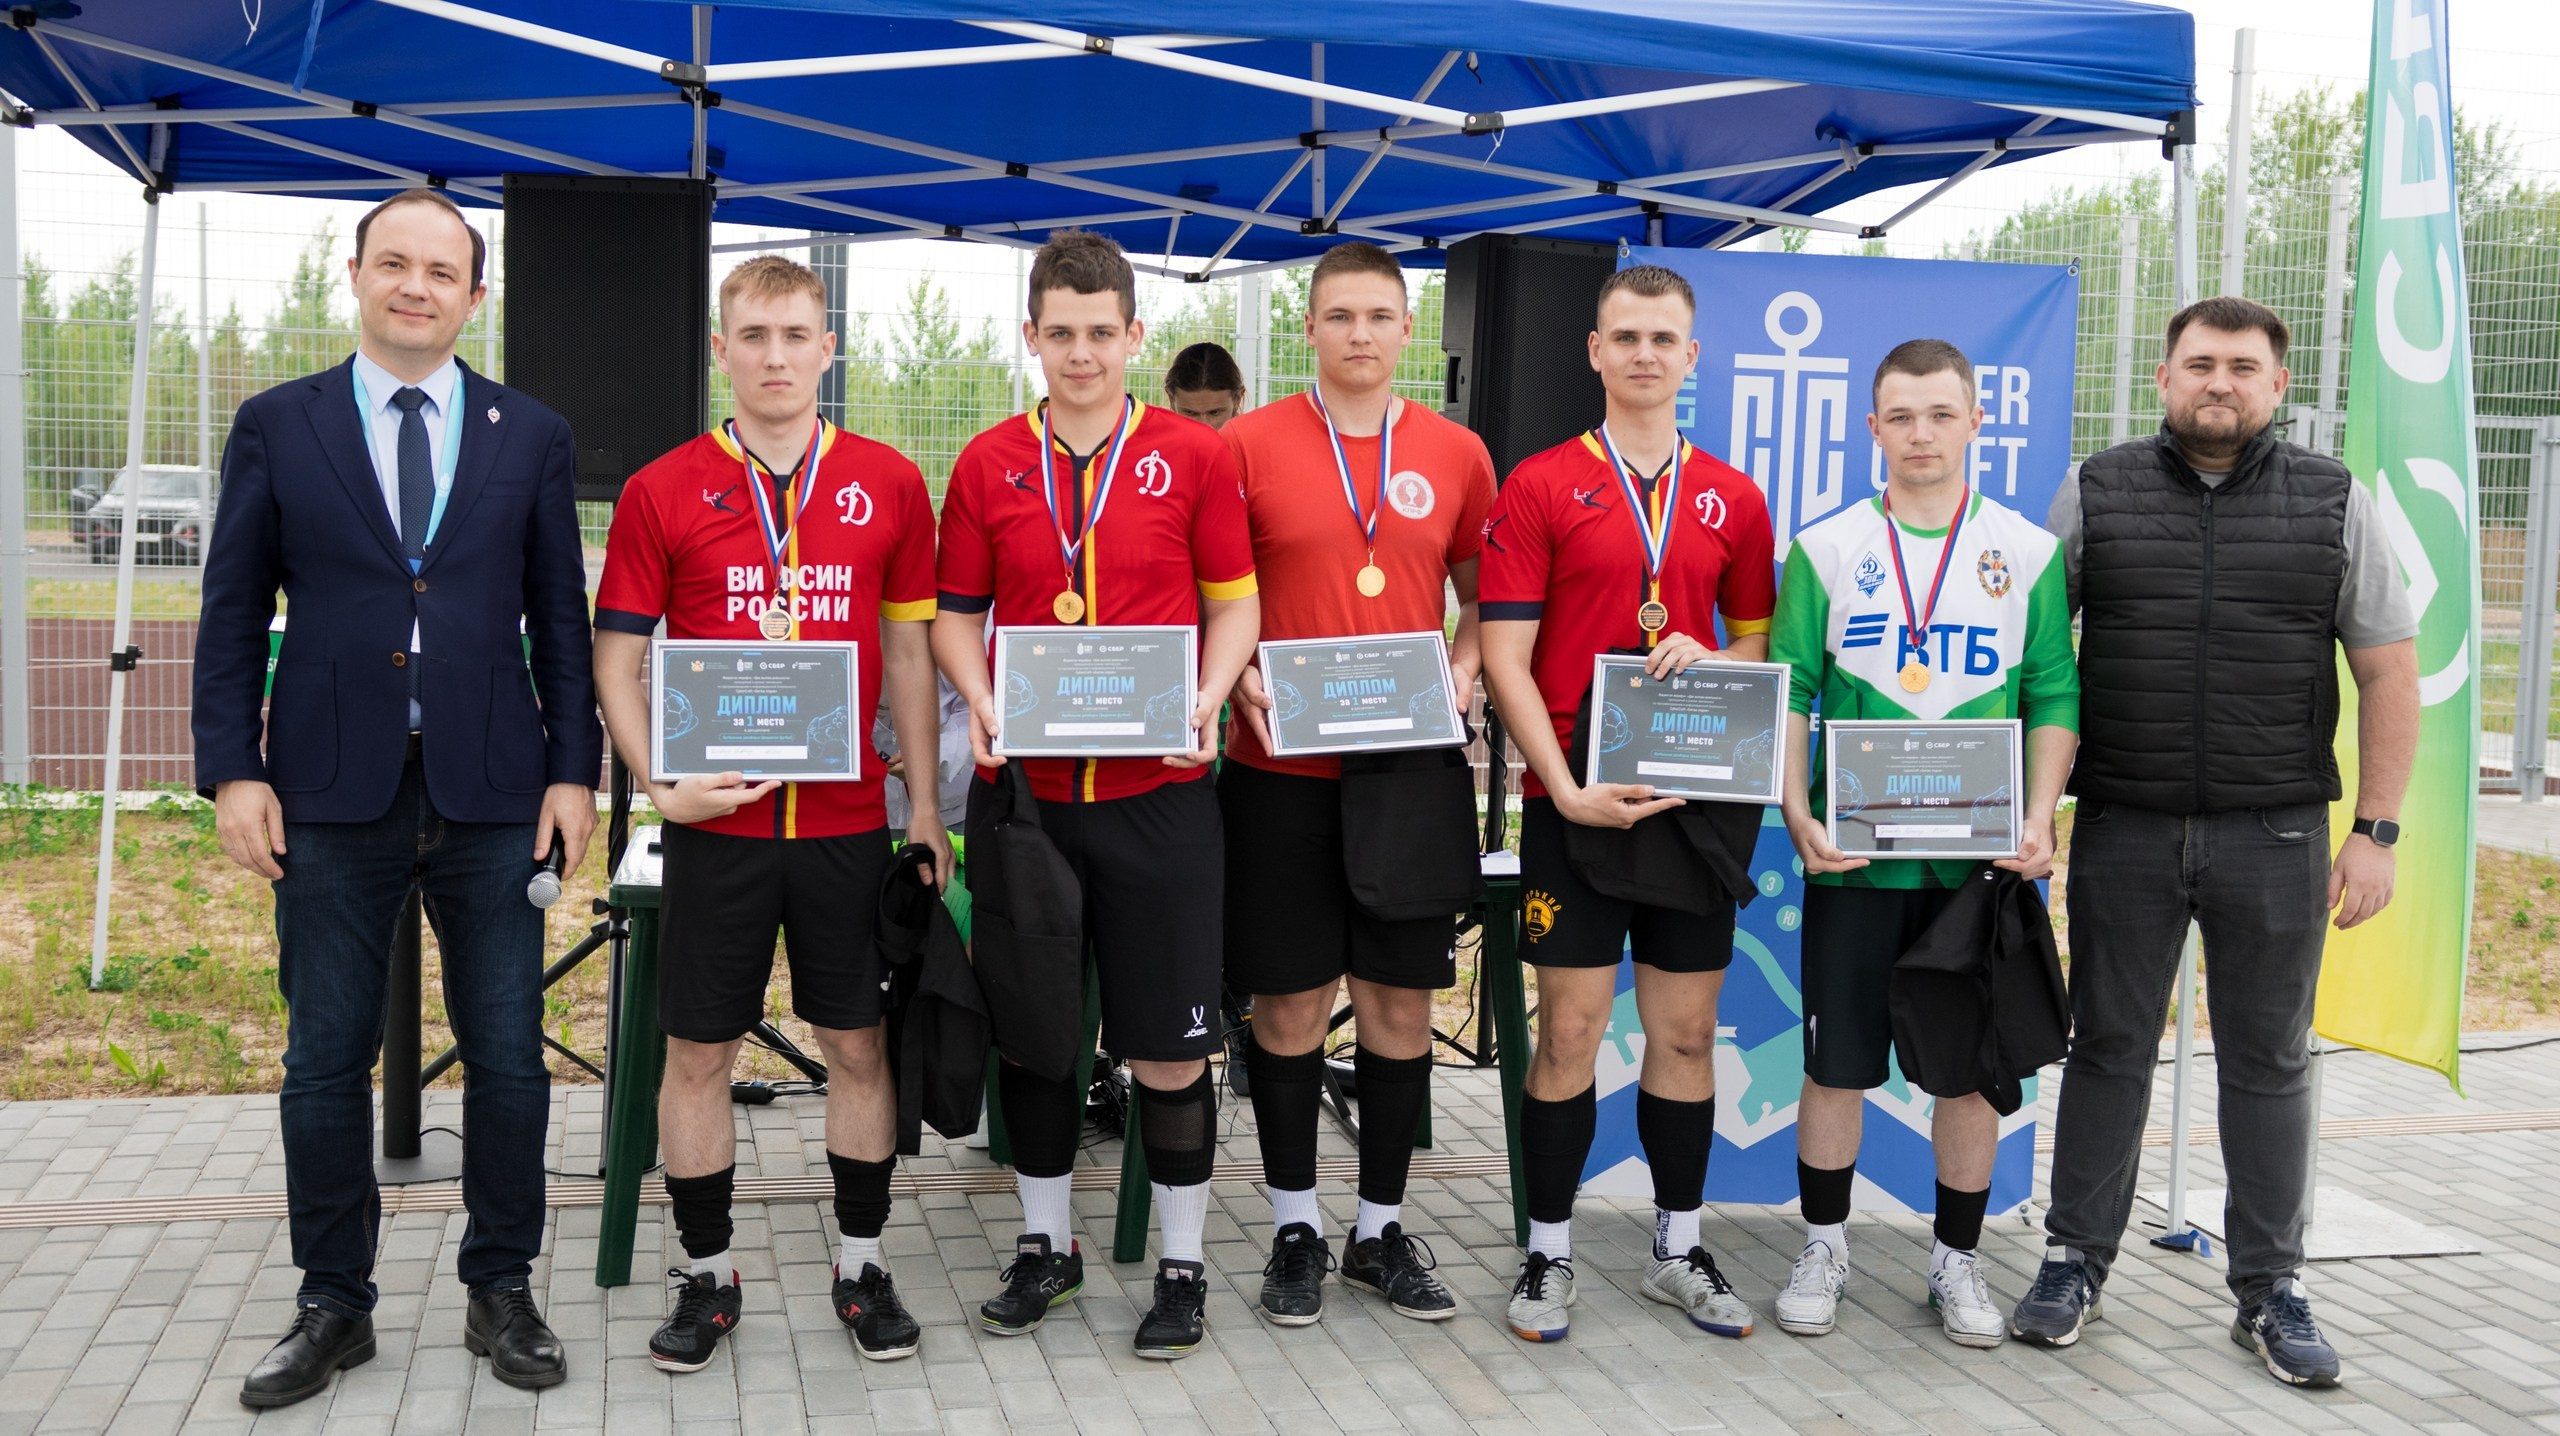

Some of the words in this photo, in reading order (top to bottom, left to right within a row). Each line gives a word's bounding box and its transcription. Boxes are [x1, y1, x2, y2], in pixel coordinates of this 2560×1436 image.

[726, 565, 765, 592] ВИ
[1896, 623, 2001, 677] ВТБ
[1056, 675, 1136, 696] ДИПЛОМ
[1323, 677, 1397, 700] ДИПЛОМ
[716, 694, 798, 717] ДИПЛОМ
[1071, 696, 1084, 706] за
[1085, 694, 1093, 706] 1
[1095, 696, 1123, 706] место
[1339, 698, 1351, 707] за
[1352, 695, 1359, 706] 1
[1361, 696, 1388, 706] место
[732, 717, 745, 727] за
[746, 715, 754, 727] 1
[756, 717, 785, 727] место
[1650, 711, 1728, 735] ДИПЛОМ
[1664, 734, 1676, 744] за
[1677, 733, 1685, 745] 1
[1686, 735, 1714, 746] место
[1885, 773, 1962, 796] ДИПЛОМ
[1900, 796, 1912, 806] за
[1913, 795, 1920, 807] 1
[1922, 796, 1950, 806] место
